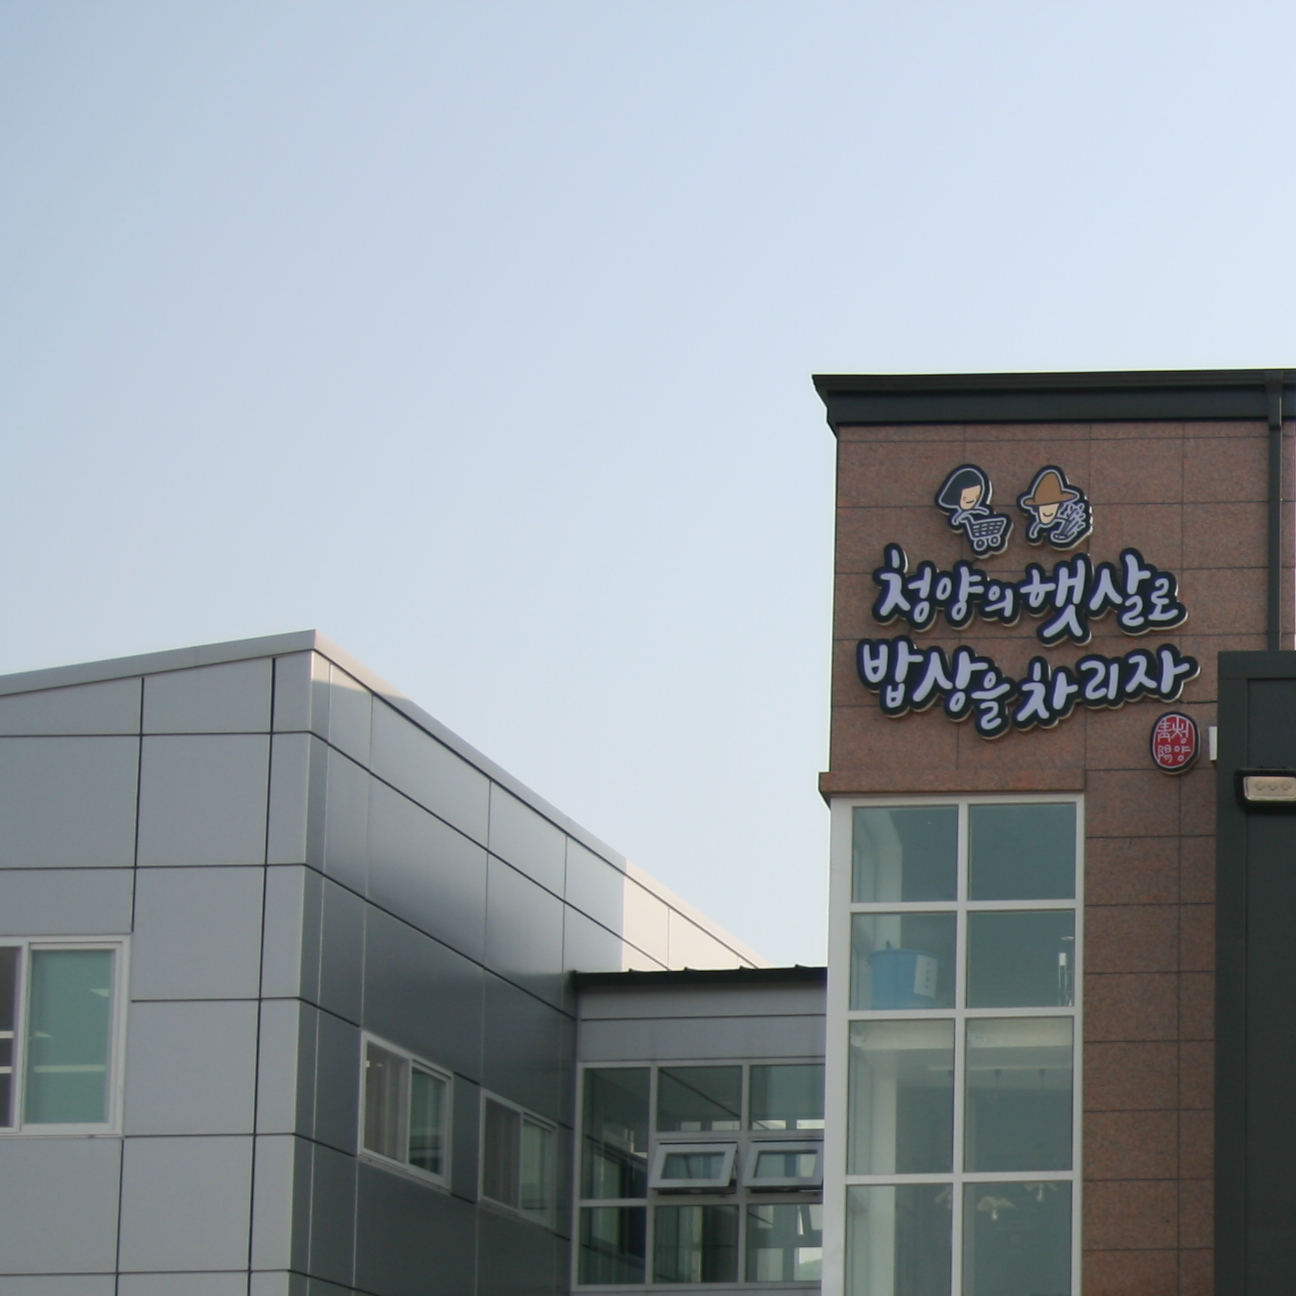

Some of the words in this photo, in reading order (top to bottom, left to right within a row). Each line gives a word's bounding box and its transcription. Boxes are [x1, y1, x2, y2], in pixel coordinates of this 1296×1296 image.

[876, 546, 1018, 627] 청양의
[1020, 550, 1187, 642] 햇살로
[860, 638, 1014, 734] 밥상을
[1014, 647, 1195, 727] 차리자
